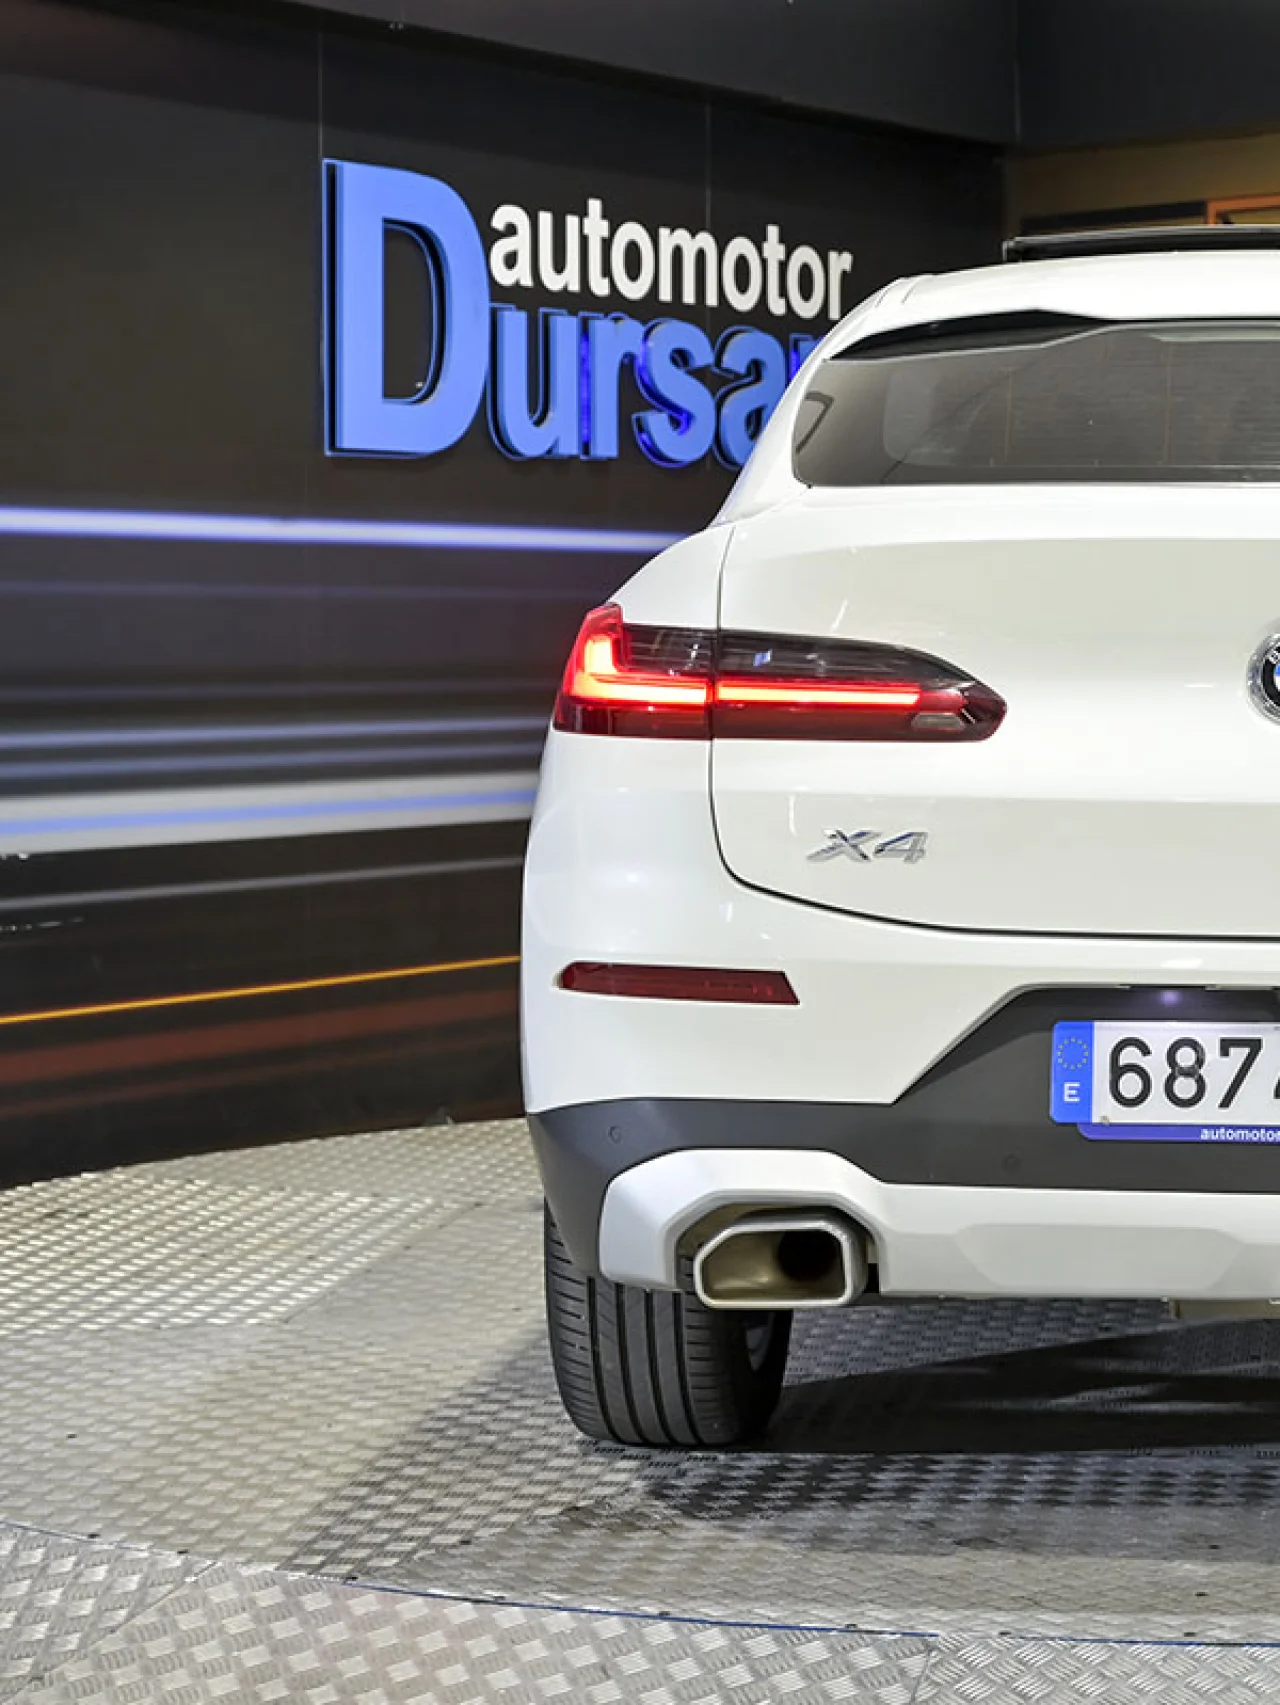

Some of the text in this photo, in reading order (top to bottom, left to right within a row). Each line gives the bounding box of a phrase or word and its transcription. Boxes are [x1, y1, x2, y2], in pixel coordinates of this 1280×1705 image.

[489, 197, 855, 321] automotor
[806, 828, 929, 863] X4
[1063, 1081, 1081, 1103] E
